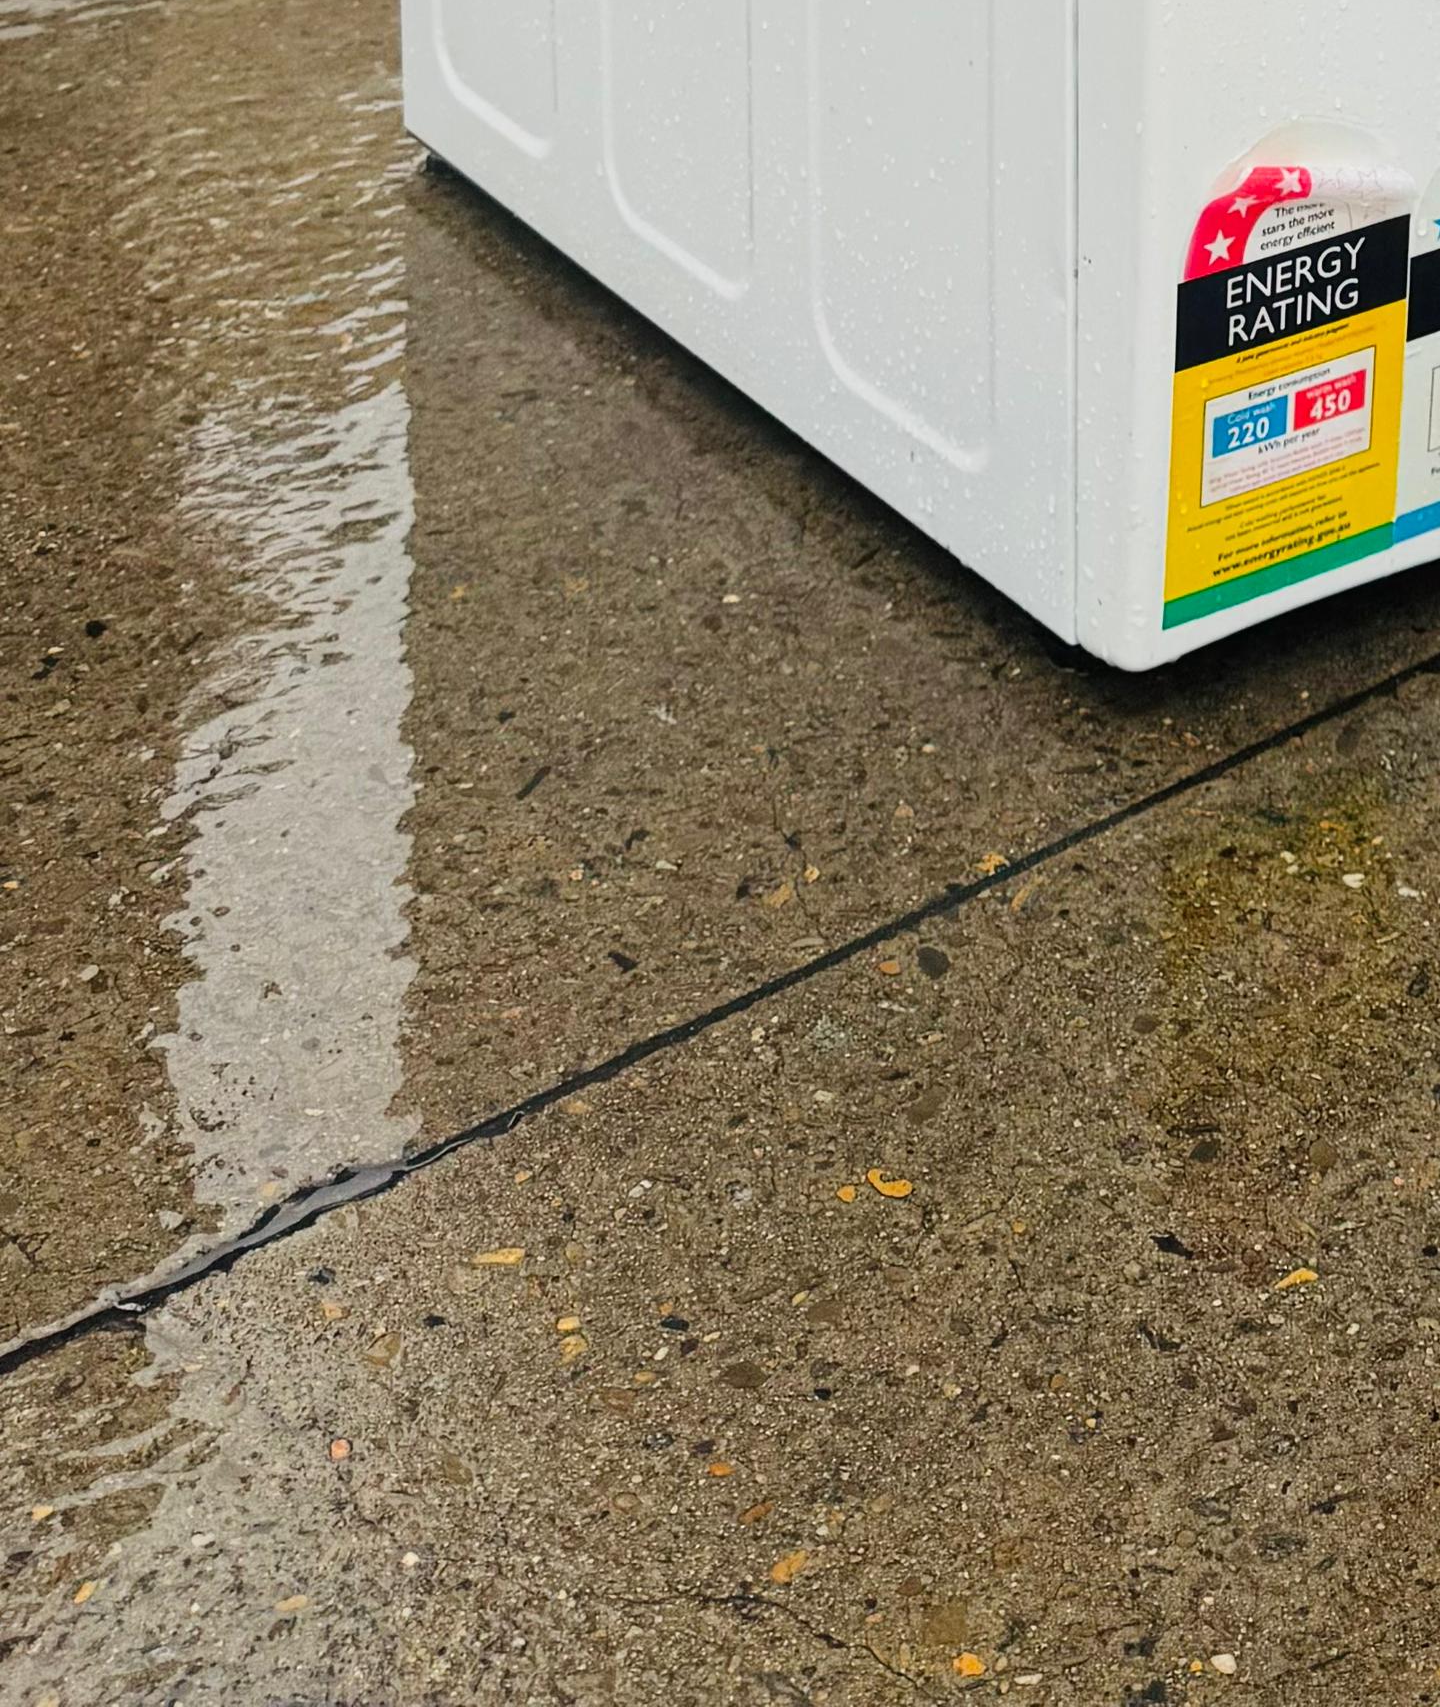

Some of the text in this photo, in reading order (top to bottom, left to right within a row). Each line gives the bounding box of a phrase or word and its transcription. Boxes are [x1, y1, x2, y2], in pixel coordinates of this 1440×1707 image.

[1262, 208, 1335, 237] stars the more
[1274, 205, 1296, 218] The
[1260, 221, 1335, 251] energy efficient
[1226, 237, 1366, 310] ENERGY
[1228, 277, 1360, 347] RATING
[1248, 384, 1277, 400] Energy
[1310, 389, 1351, 420] 450
[1228, 417, 1270, 449] 220
[1257, 440, 1281, 454] kWh
[1283, 436, 1298, 449] per
[1301, 428, 1321, 442] year
[1212, 522, 1351, 577] www.energyrating.gov.au
[1218, 551, 1234, 562] For
[1236, 543, 1259, 555] more
[1315, 513, 1336, 526] refer
